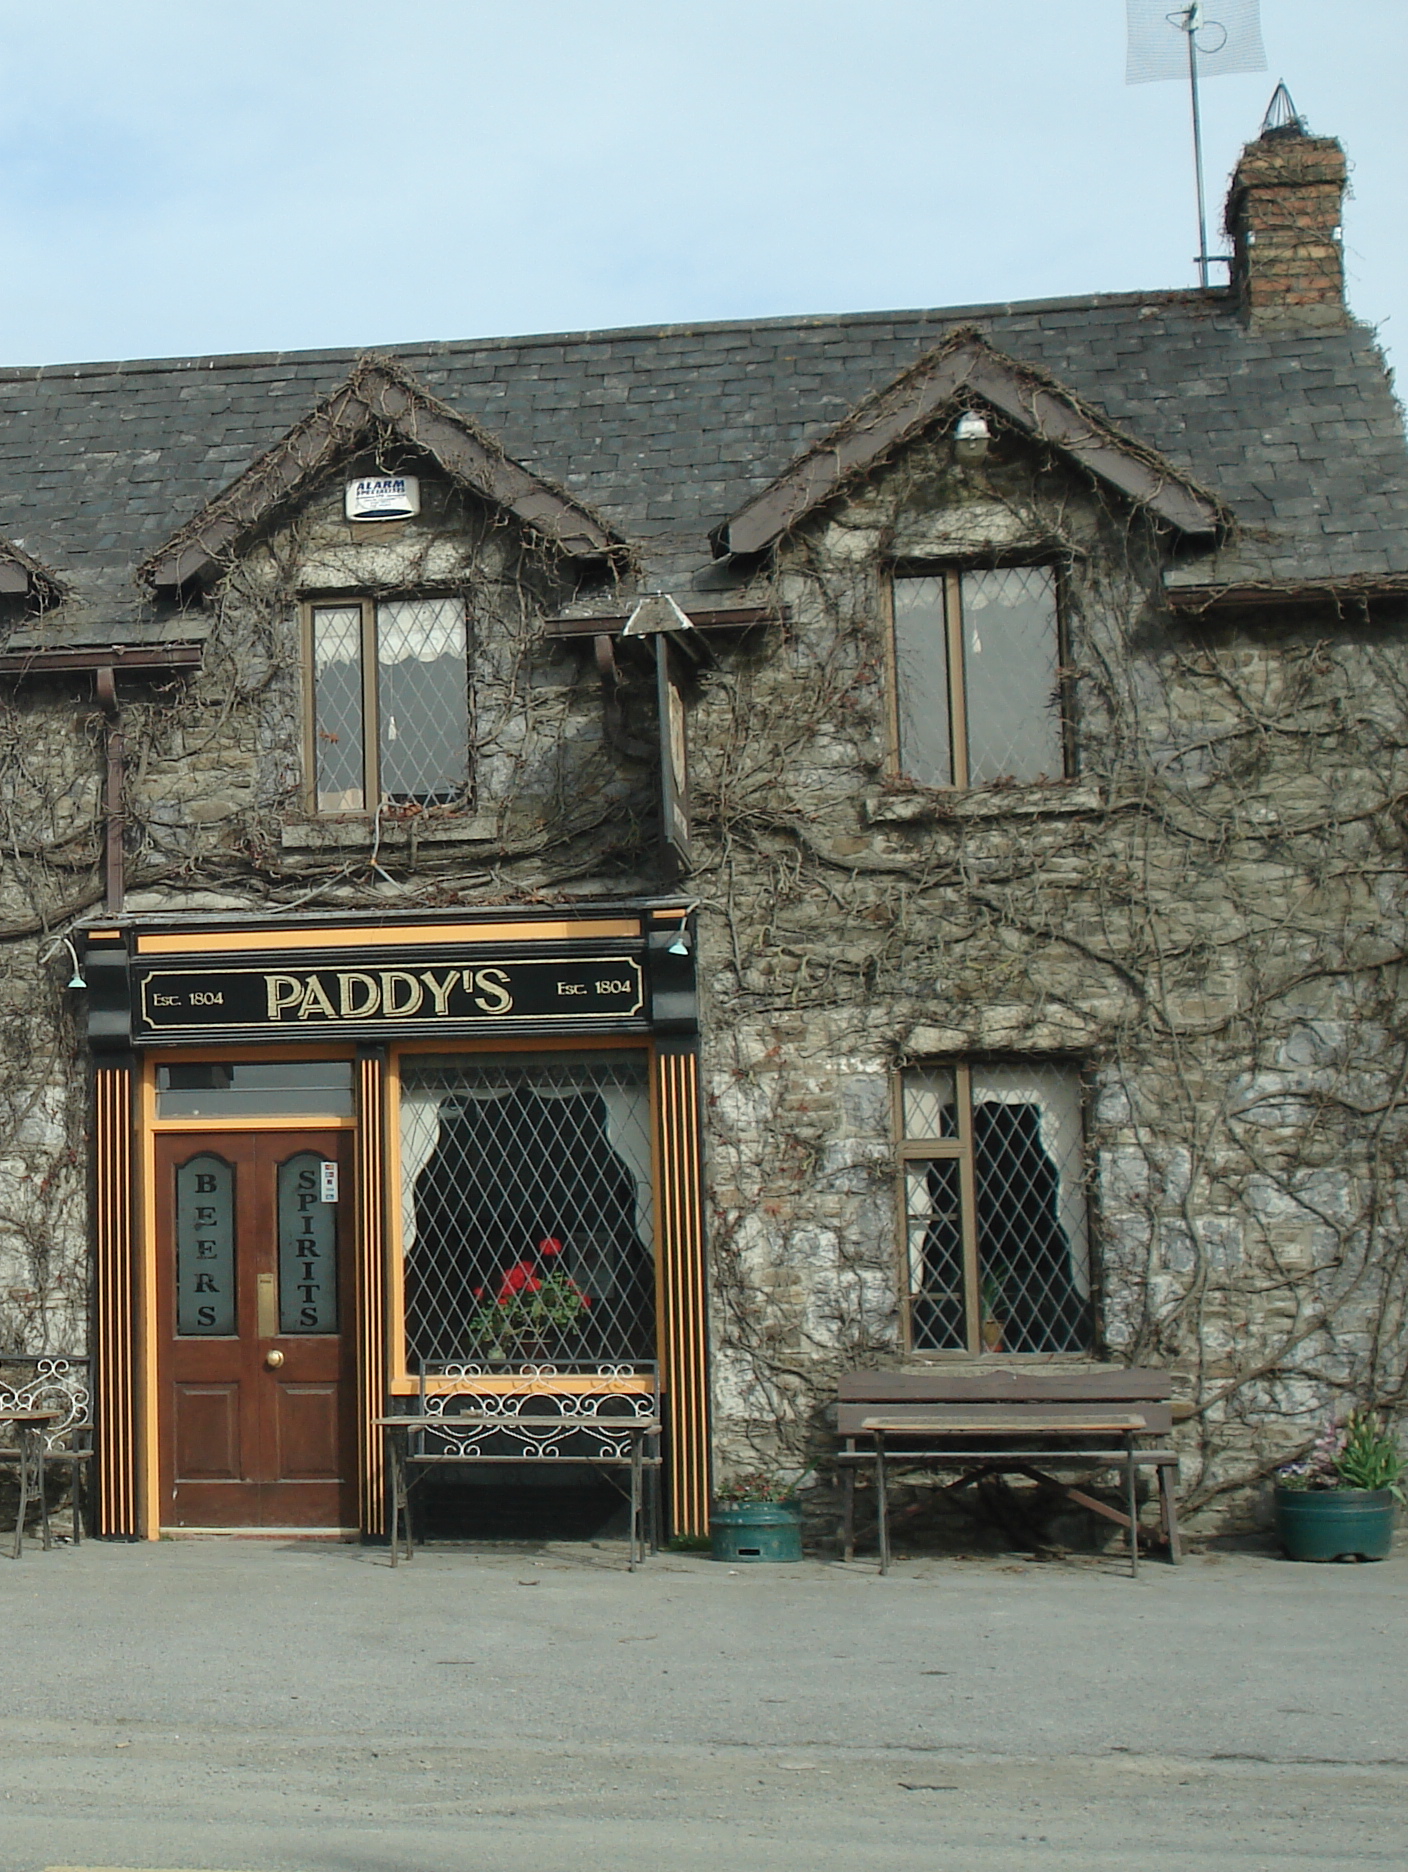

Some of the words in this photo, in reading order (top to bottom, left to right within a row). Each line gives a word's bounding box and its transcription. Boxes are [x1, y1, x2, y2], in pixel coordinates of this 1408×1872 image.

[356, 479, 405, 490] ALARM
[188, 992, 224, 1006] 1804
[263, 968, 514, 1020] PADDY'S
[594, 980, 632, 994] 1804
[194, 1173, 220, 1327] BEERS
[295, 1170, 321, 1327] SPIRITS
